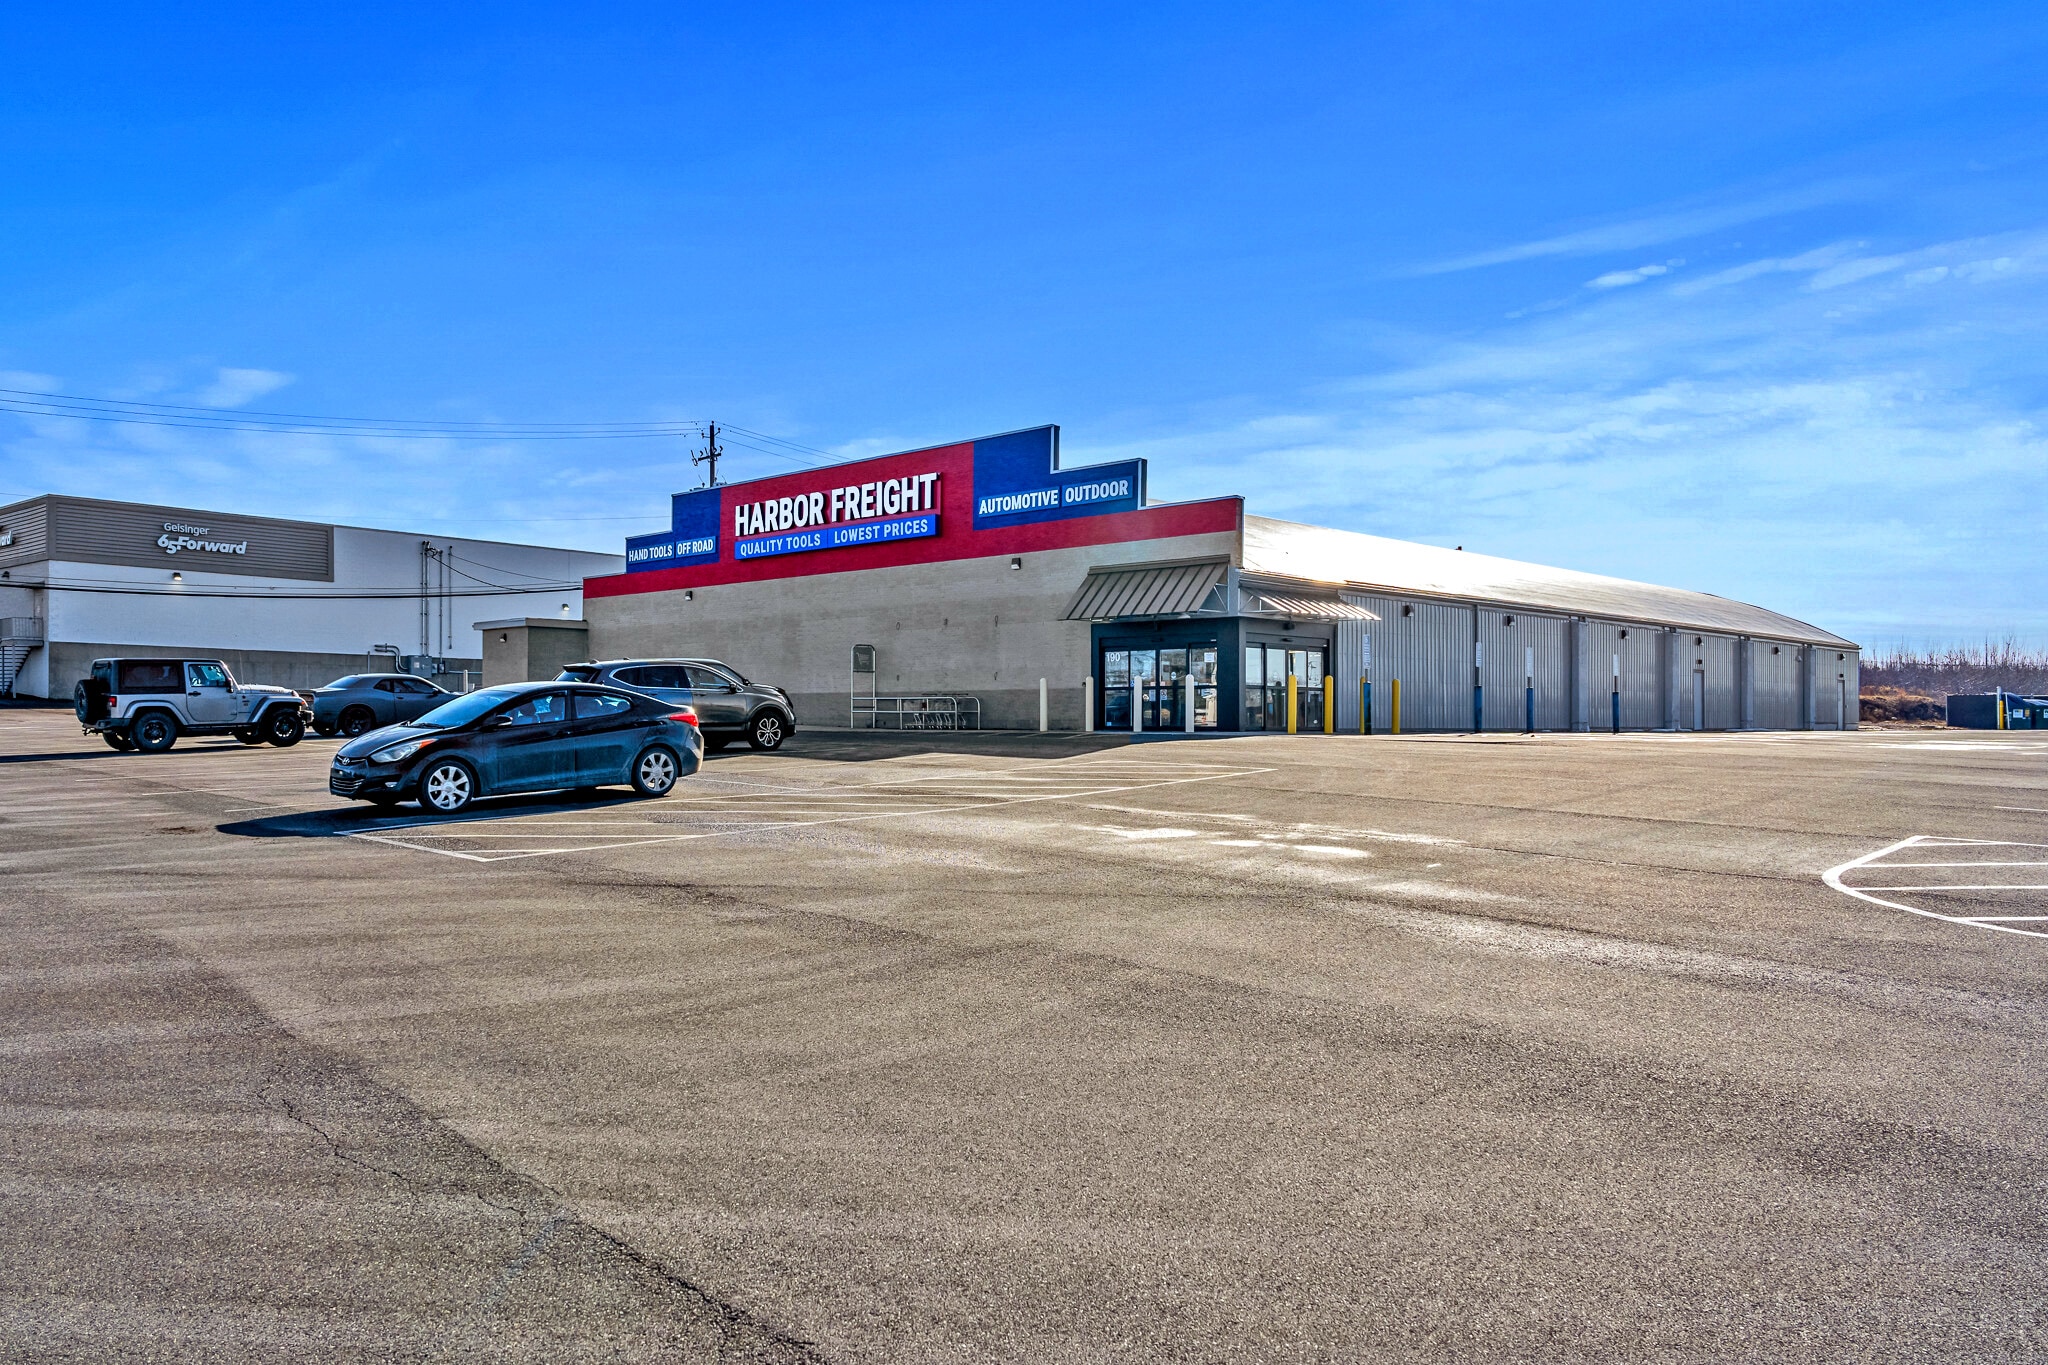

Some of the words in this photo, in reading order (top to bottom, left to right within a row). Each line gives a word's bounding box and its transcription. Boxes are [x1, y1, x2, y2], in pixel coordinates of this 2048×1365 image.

[734, 491, 825, 537] HARBOR
[831, 472, 939, 522] FREIGHT
[978, 489, 1059, 515] AUTOMOTIVE
[1065, 480, 1129, 503] OUTDOOR
[163, 522, 210, 536] Geisinger
[740, 538, 783, 556] QUALITY
[785, 533, 821, 550] TOOLS
[834, 525, 880, 544] LOWEST
[883, 519, 928, 537] PRICES
[628, 548, 649, 561] HAND
[649, 544, 673, 558] TOOLS
[677, 541, 691, 555] OFF
[692, 539, 713, 553] ROAD
[1106, 652, 1120, 662] 190
